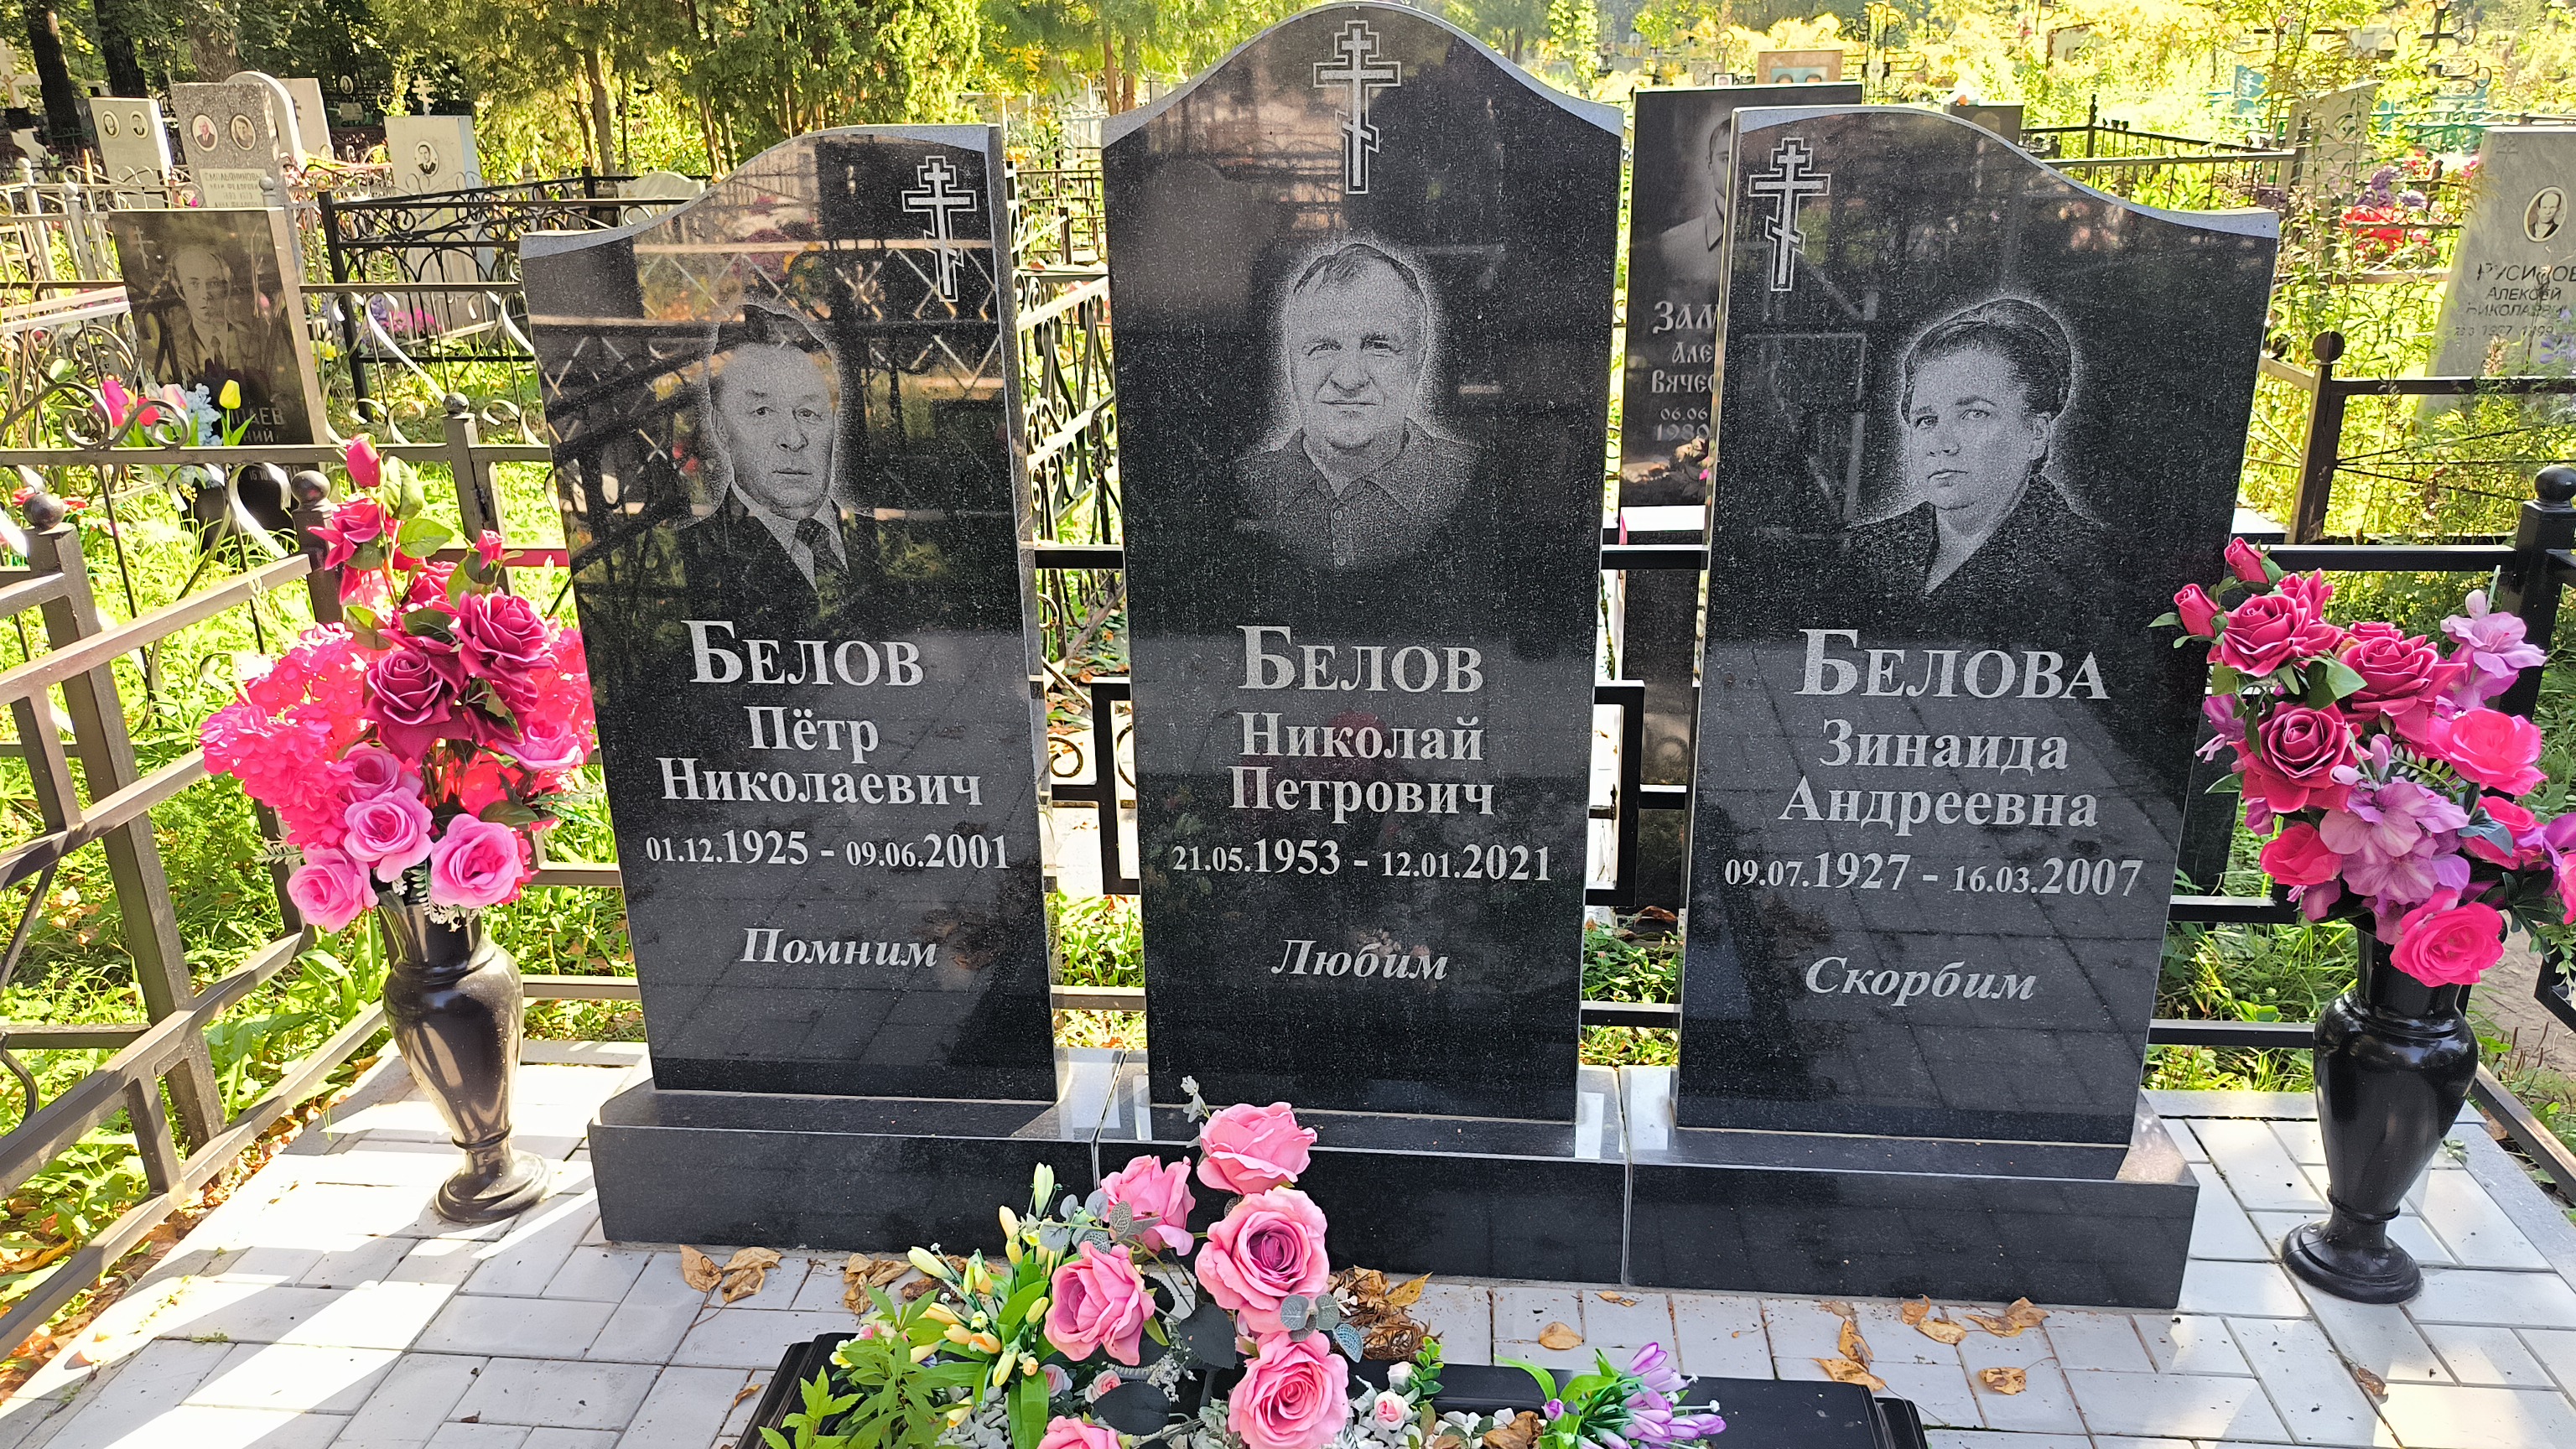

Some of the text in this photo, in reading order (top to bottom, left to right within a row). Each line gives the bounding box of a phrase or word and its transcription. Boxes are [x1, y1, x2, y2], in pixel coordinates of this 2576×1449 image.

[680, 620, 924, 687] БЕЛОВ
[1236, 625, 1484, 693] БЕЛОВ
[1793, 628, 2111, 700] БЕЛОВА
[742, 705, 880, 764] Пётр
[1237, 712, 1484, 761] Николай
[1818, 719, 2070, 776] Зинаида
[655, 756, 983, 806] Николаевич
[1227, 766, 1496, 824] Петрович
[1777, 775, 2099, 837] Андреевна
[646, 828, 809, 865] 01.12.1925
[845, 833, 1010, 870] 09.06.2001
[1172, 838, 1342, 875] 21.05.1953
[1381, 844, 1552, 881] 12.01.2021
[1724, 851, 1912, 891] 09.07.1927
[1952, 858, 2143, 897] 16.03.2007
[740, 927, 937, 967] Помним
[1270, 939, 1449, 980] Любим
[1805, 956, 2038, 1007] Скорбим
